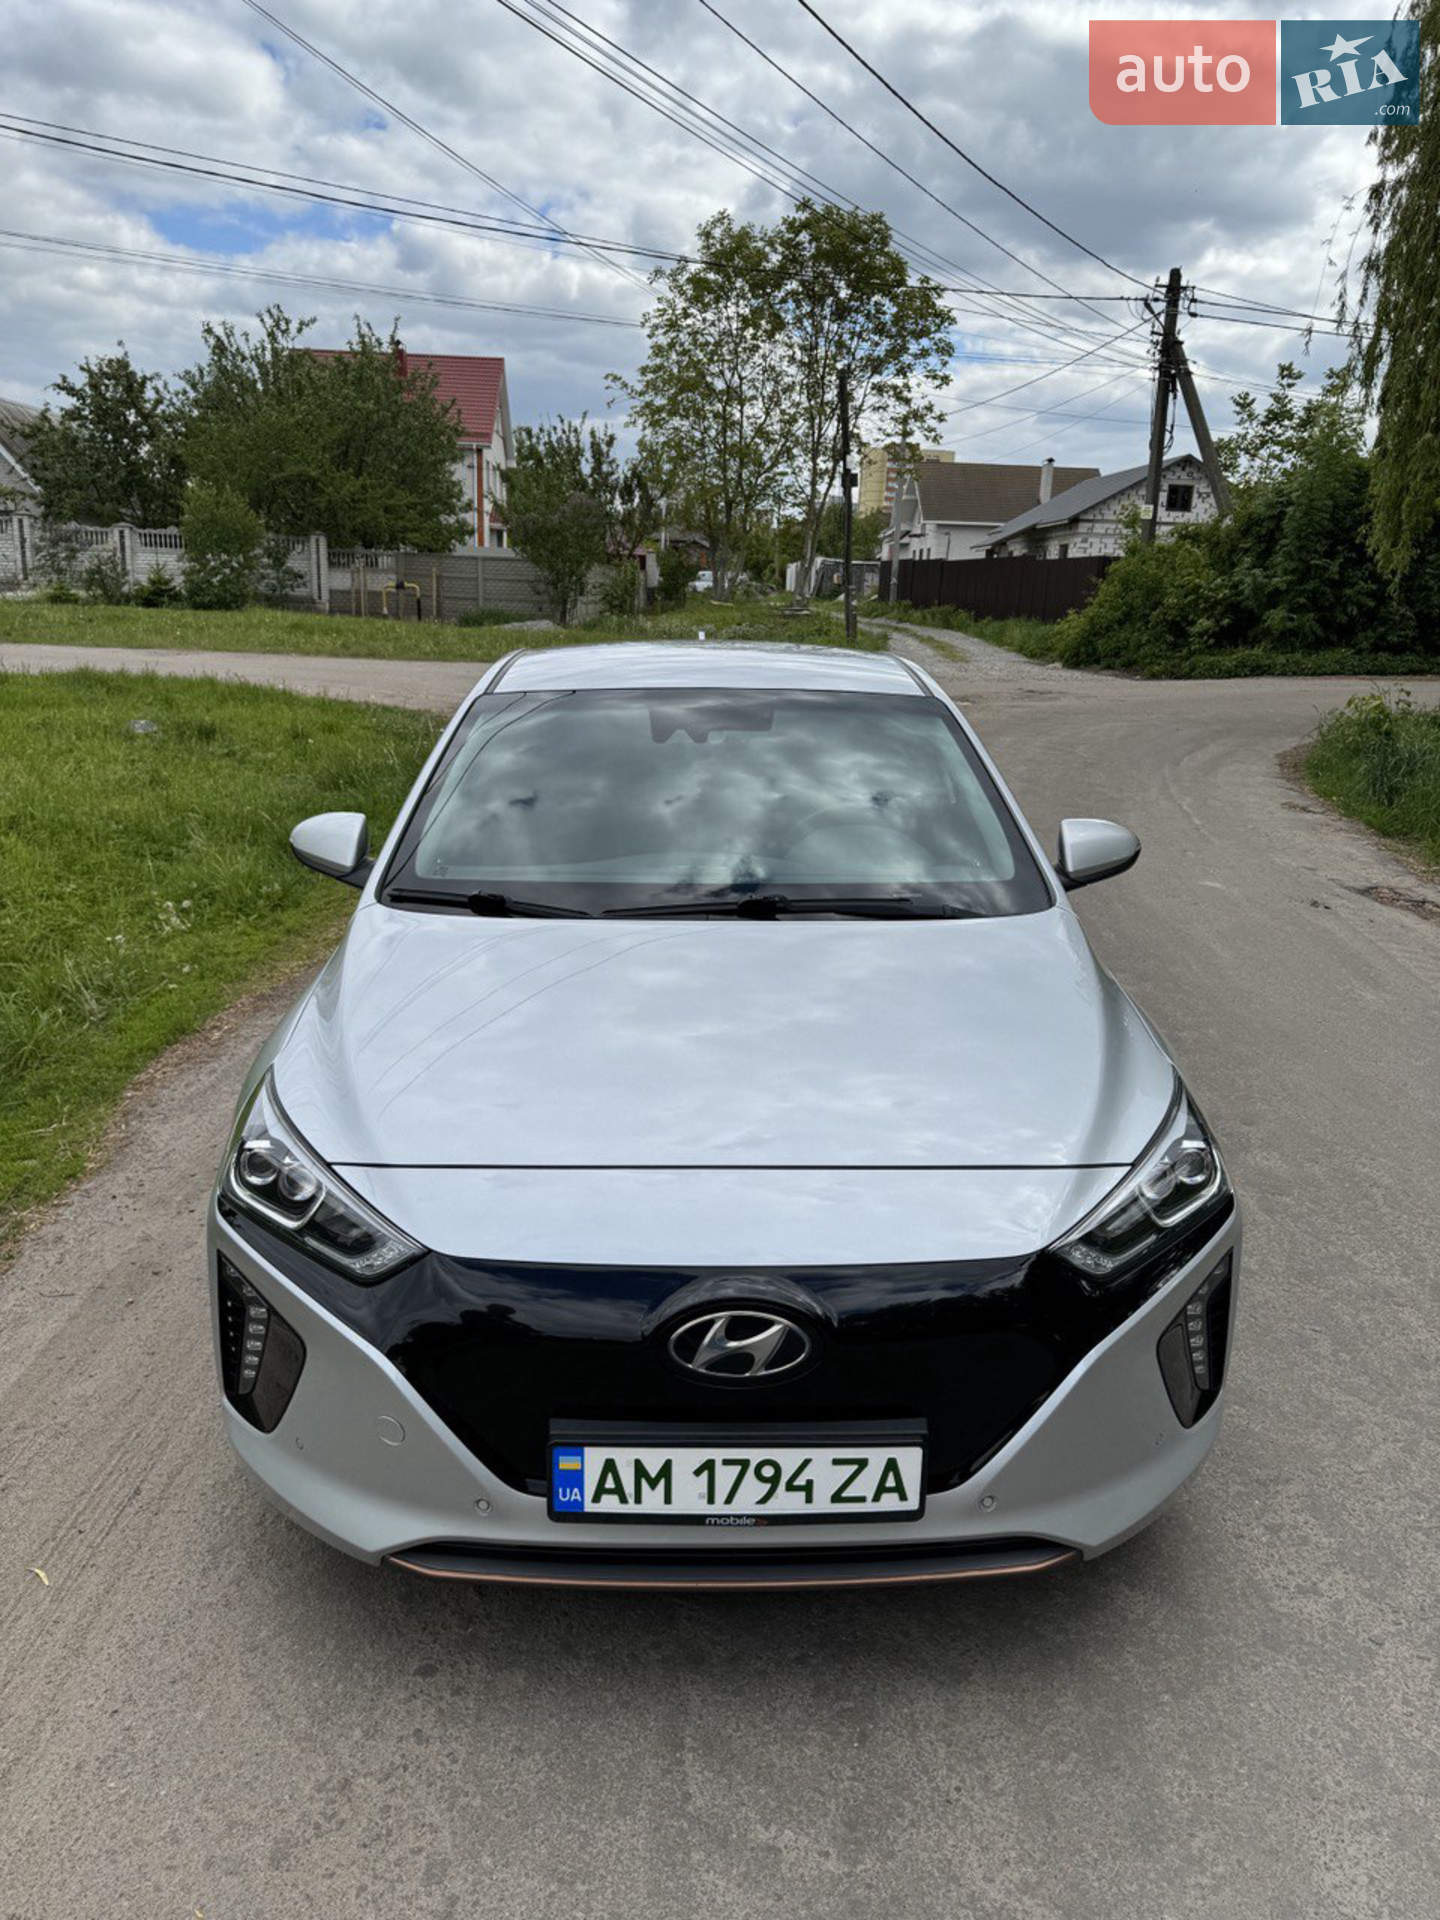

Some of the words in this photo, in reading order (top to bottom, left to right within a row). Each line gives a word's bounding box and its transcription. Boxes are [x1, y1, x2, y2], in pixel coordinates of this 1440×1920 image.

[559, 1487, 582, 1502] UA
[591, 1457, 672, 1505] AM
[693, 1457, 814, 1505] 1794
[830, 1457, 908, 1504] ZA
